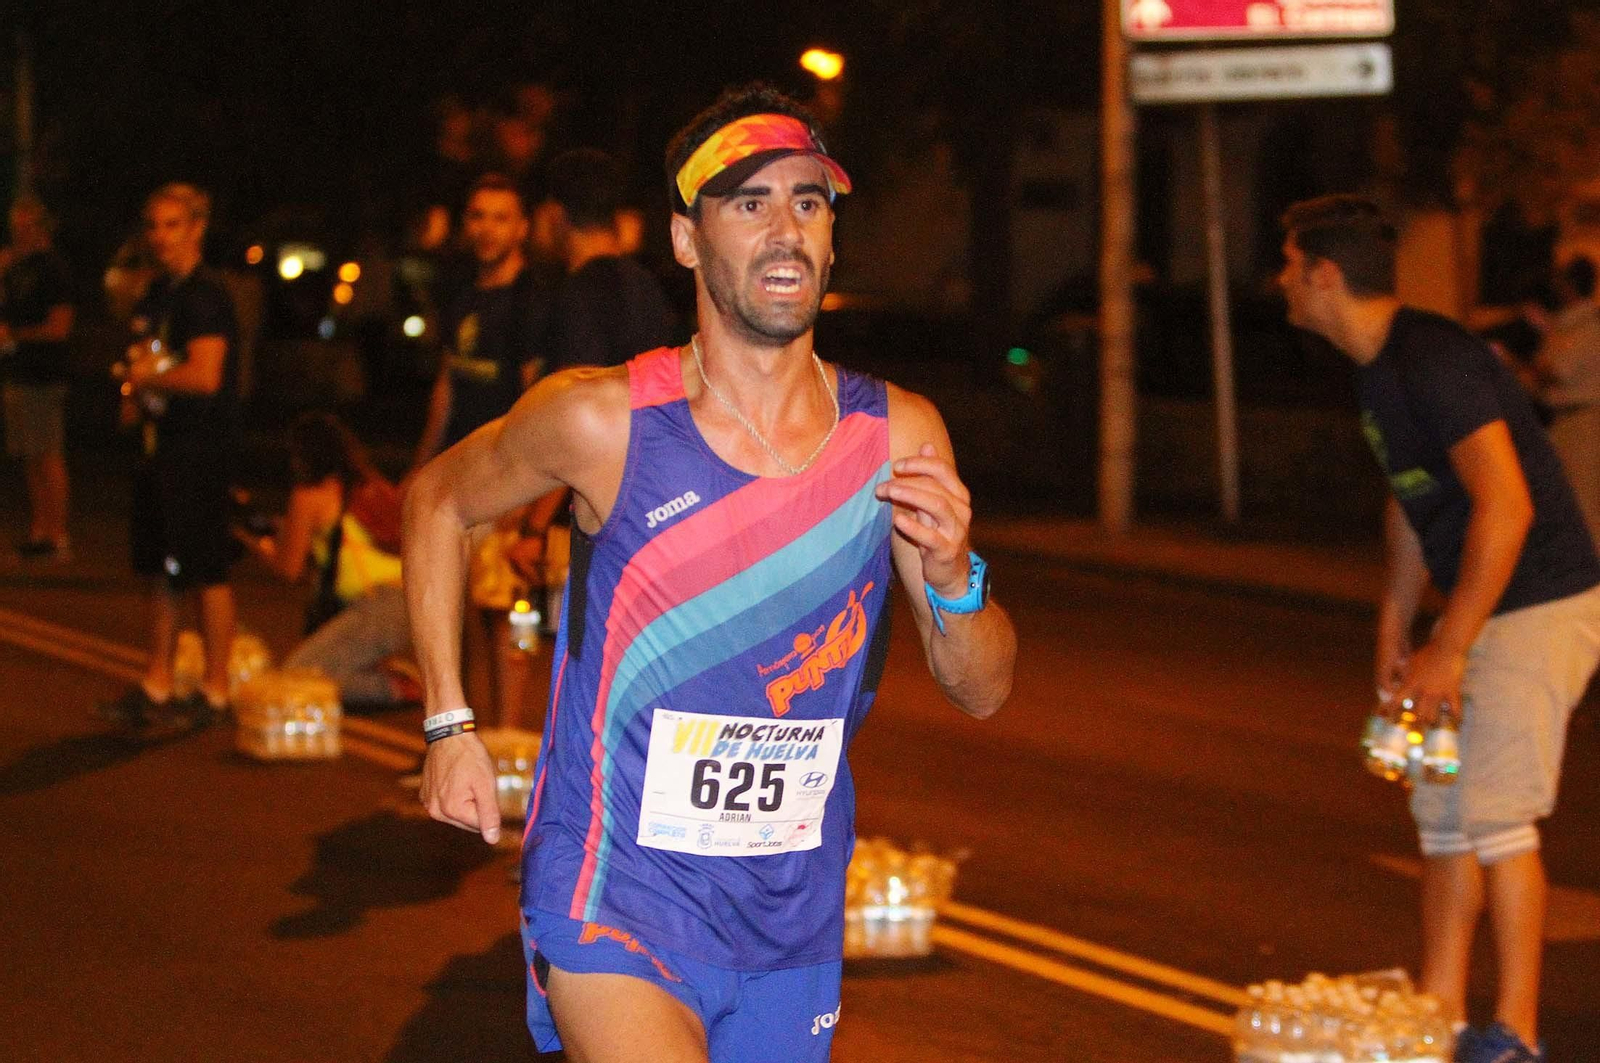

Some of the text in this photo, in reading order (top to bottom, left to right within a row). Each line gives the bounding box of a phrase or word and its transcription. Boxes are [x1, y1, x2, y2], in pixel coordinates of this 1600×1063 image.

[672, 719, 720, 756] VII
[719, 722, 825, 743] NOCTURNA
[710, 740, 819, 761] DE HUELVA
[690, 759, 786, 812] 625
[719, 812, 751, 823] ADRIAN
